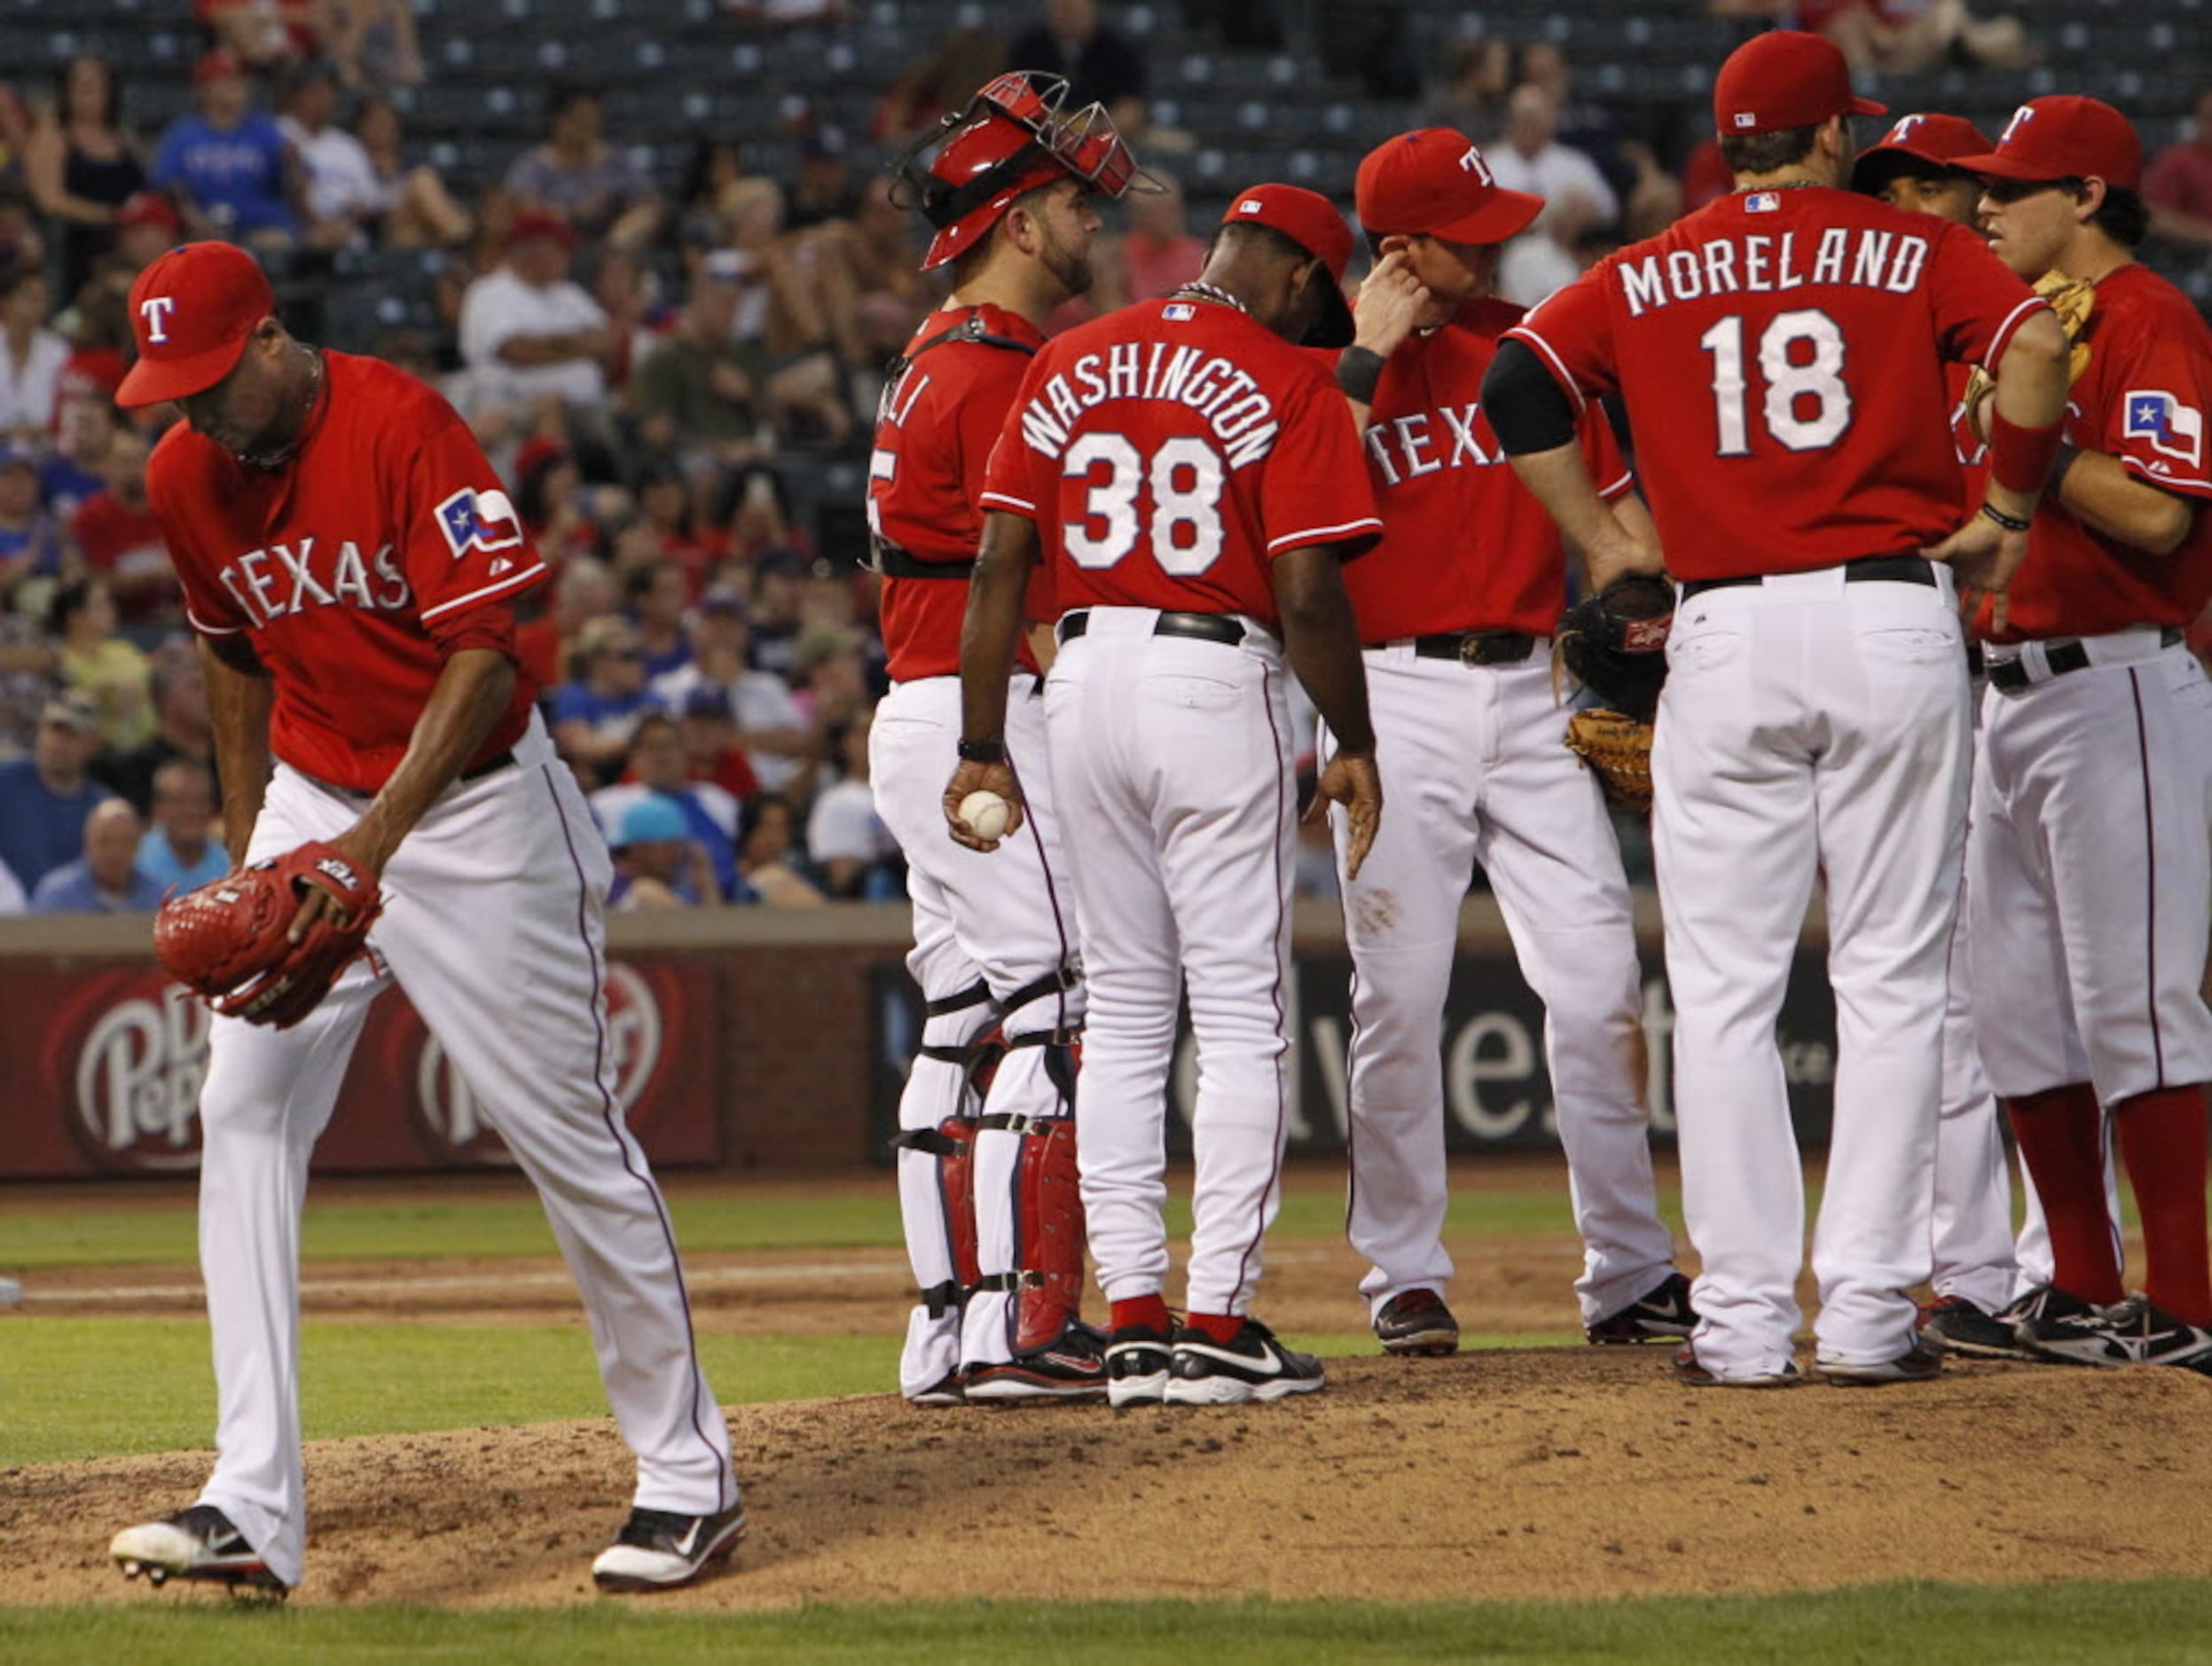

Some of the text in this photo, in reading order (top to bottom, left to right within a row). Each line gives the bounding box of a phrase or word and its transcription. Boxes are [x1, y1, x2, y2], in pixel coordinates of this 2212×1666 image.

[1459, 145, 1494, 188] T
[1892, 114, 1926, 143] T
[2002, 105, 2036, 142] T
[1617, 227, 1929, 318] MORELAND
[140, 296, 174, 344] T
[1021, 342, 1279, 471] WASHINGTON
[1700, 307, 1854, 457] 18
[1364, 402, 1508, 485] TEX
[1062, 431, 1227, 577] 38
[219, 537, 410, 630] TEXAS
